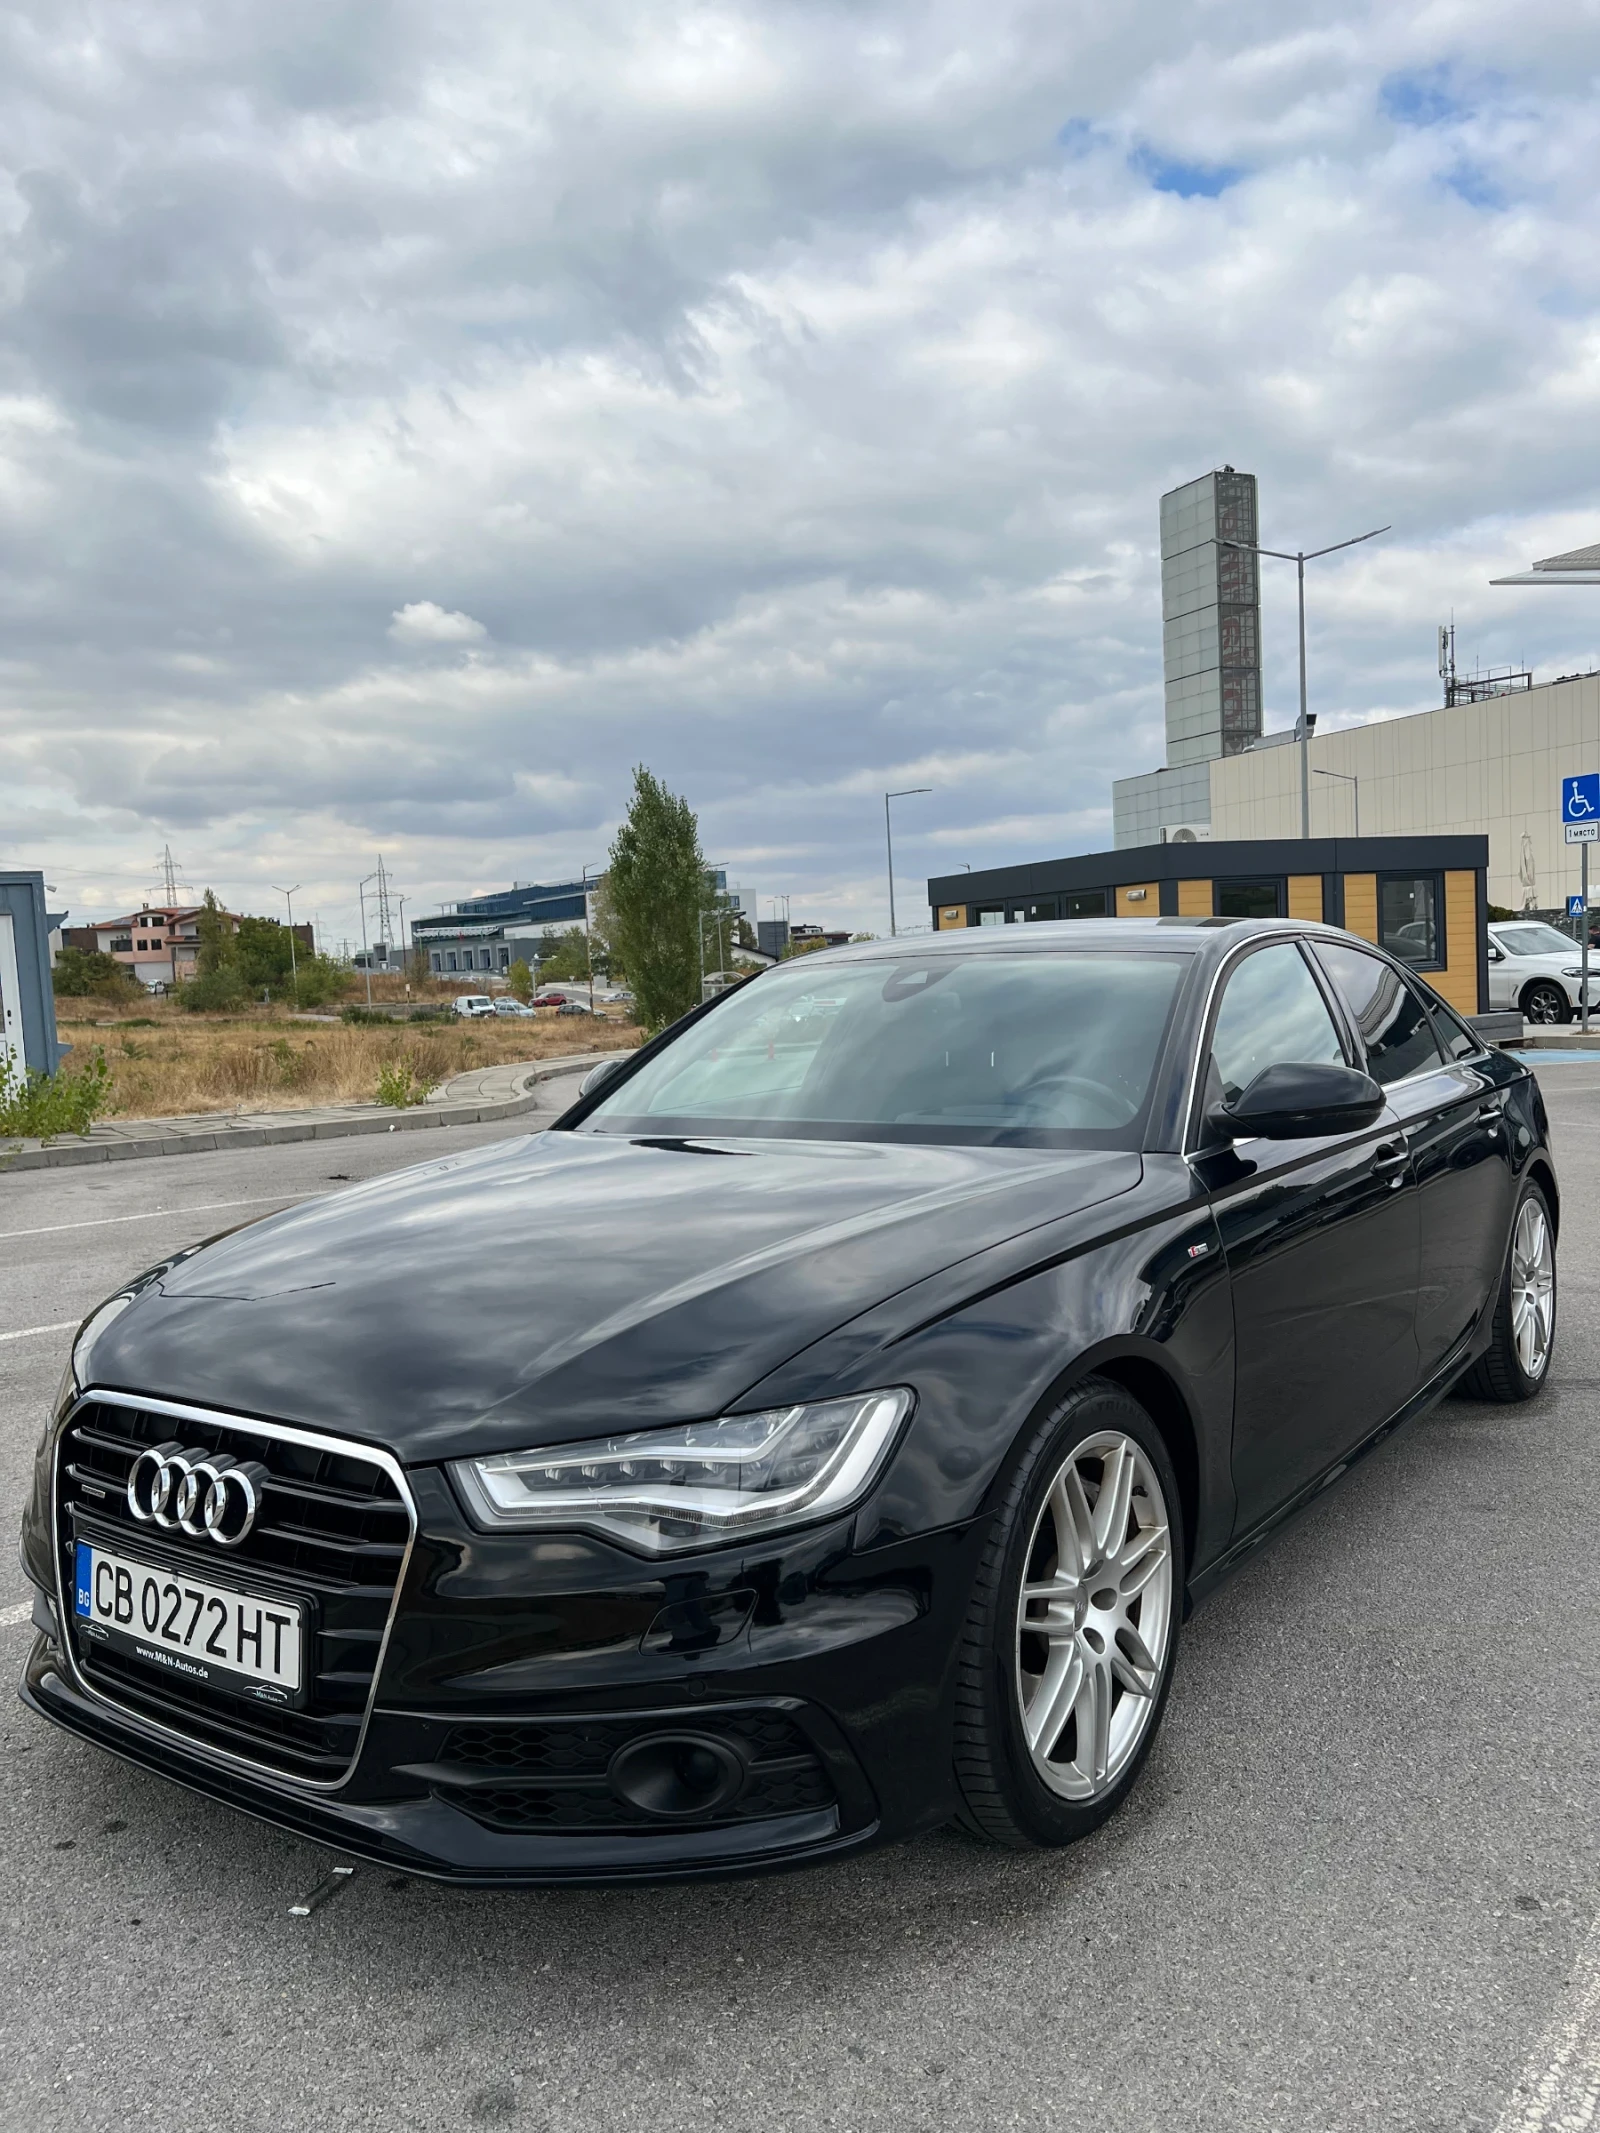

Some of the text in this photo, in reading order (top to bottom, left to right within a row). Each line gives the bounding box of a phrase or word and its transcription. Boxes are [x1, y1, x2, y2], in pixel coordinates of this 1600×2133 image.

[1573, 829, 1595, 837] МЯСТО
[78, 1587, 90, 1607] BG
[136, 1646, 209, 1679] www.M&N-Autos.de
